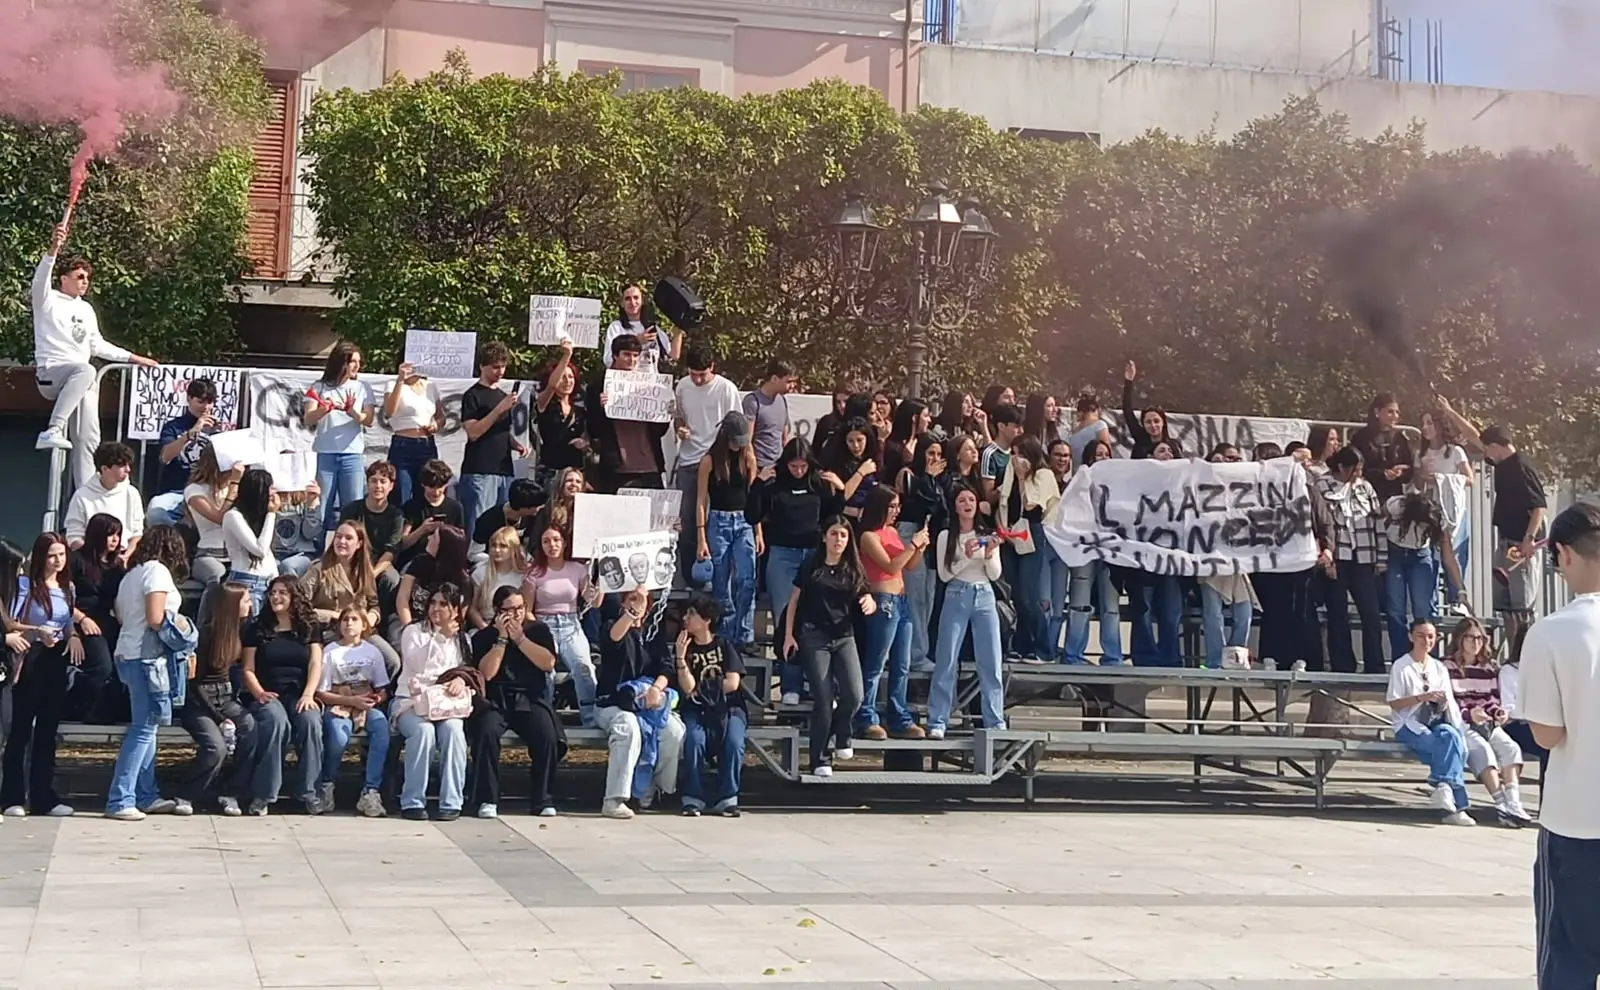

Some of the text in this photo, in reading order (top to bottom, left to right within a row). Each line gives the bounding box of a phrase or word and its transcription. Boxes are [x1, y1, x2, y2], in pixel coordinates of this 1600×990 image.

[138, 366, 238, 382] NON CI AVETE
[136, 379, 166, 392] DATO
[139, 391, 180, 405] SIAMO
[135, 403, 146, 417] IL
